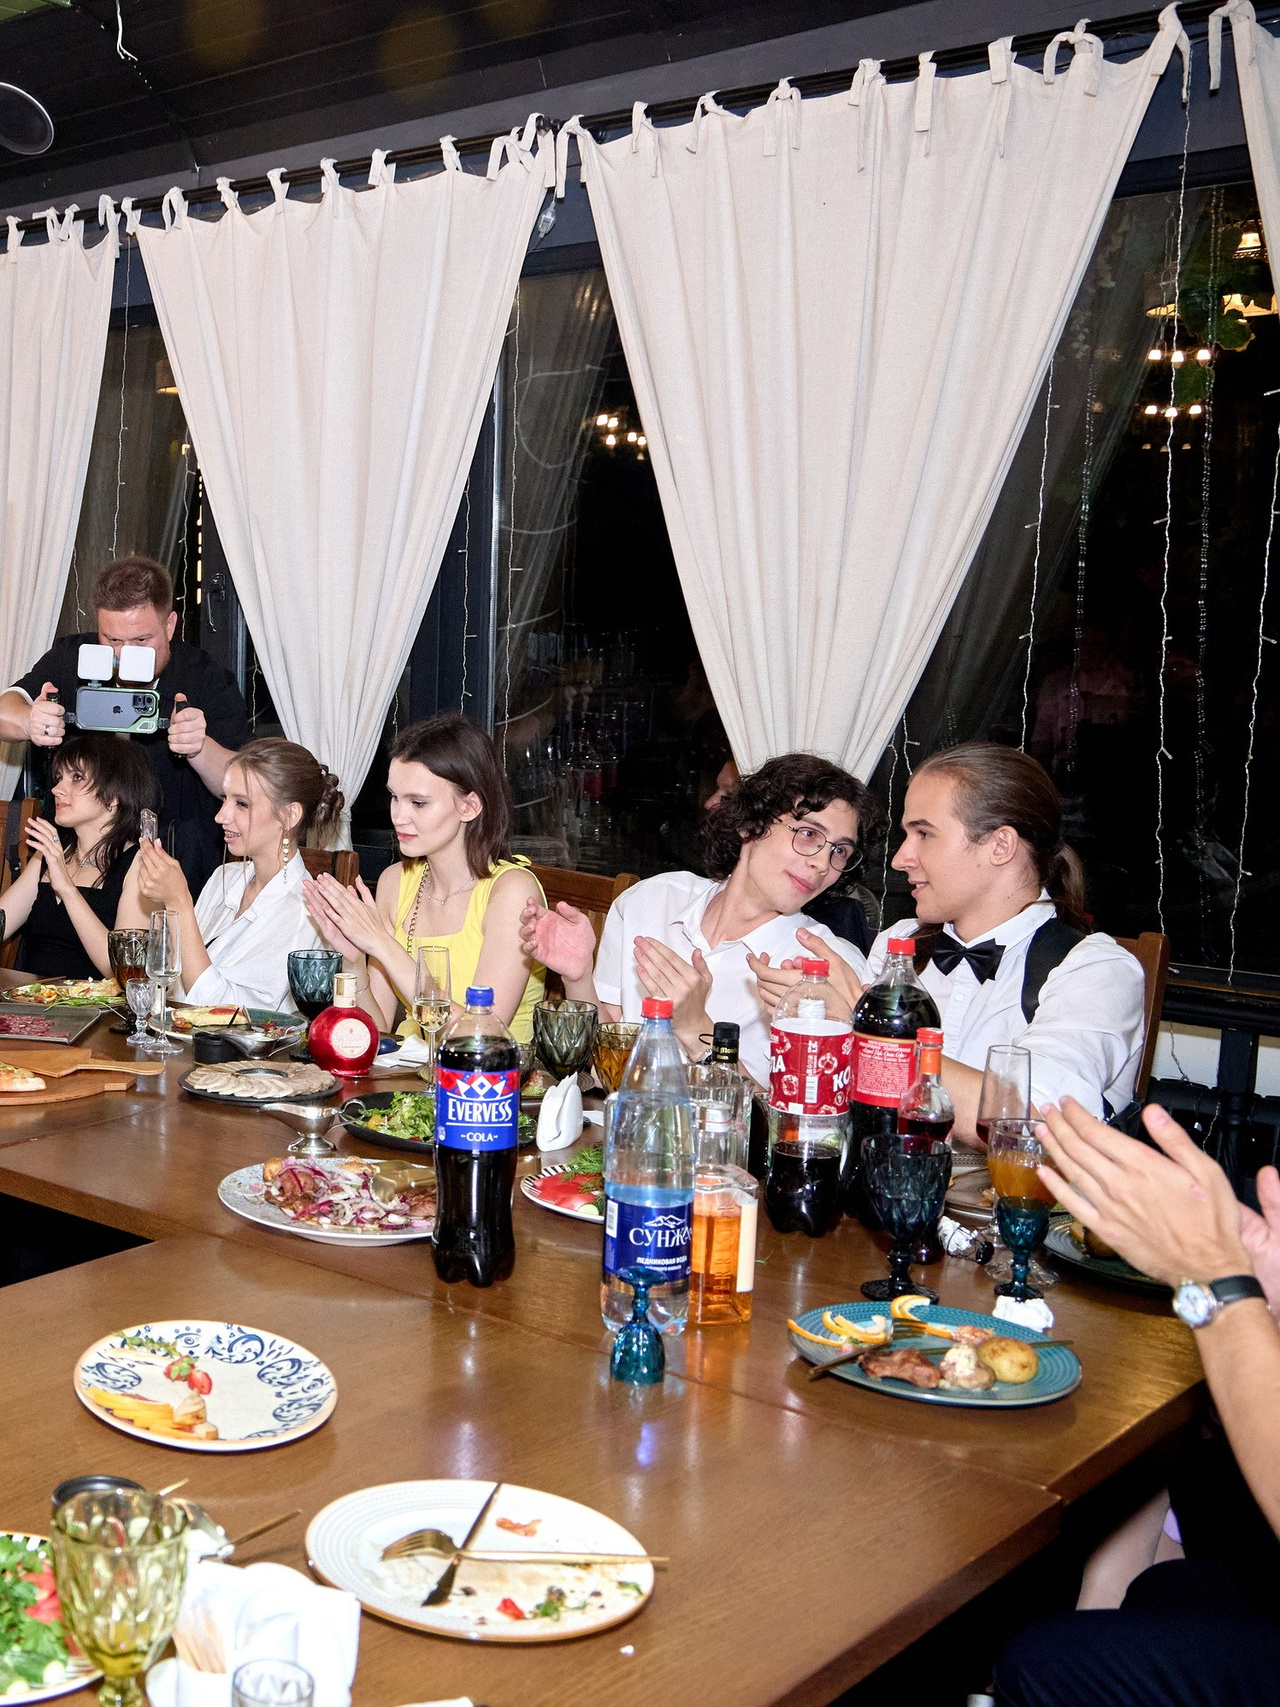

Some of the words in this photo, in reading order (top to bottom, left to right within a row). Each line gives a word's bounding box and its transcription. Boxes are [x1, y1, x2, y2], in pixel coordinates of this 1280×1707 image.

[448, 1098, 512, 1122] EVERVESS
[466, 1132, 494, 1142] COLA
[628, 1226, 691, 1248] СУНЖА
